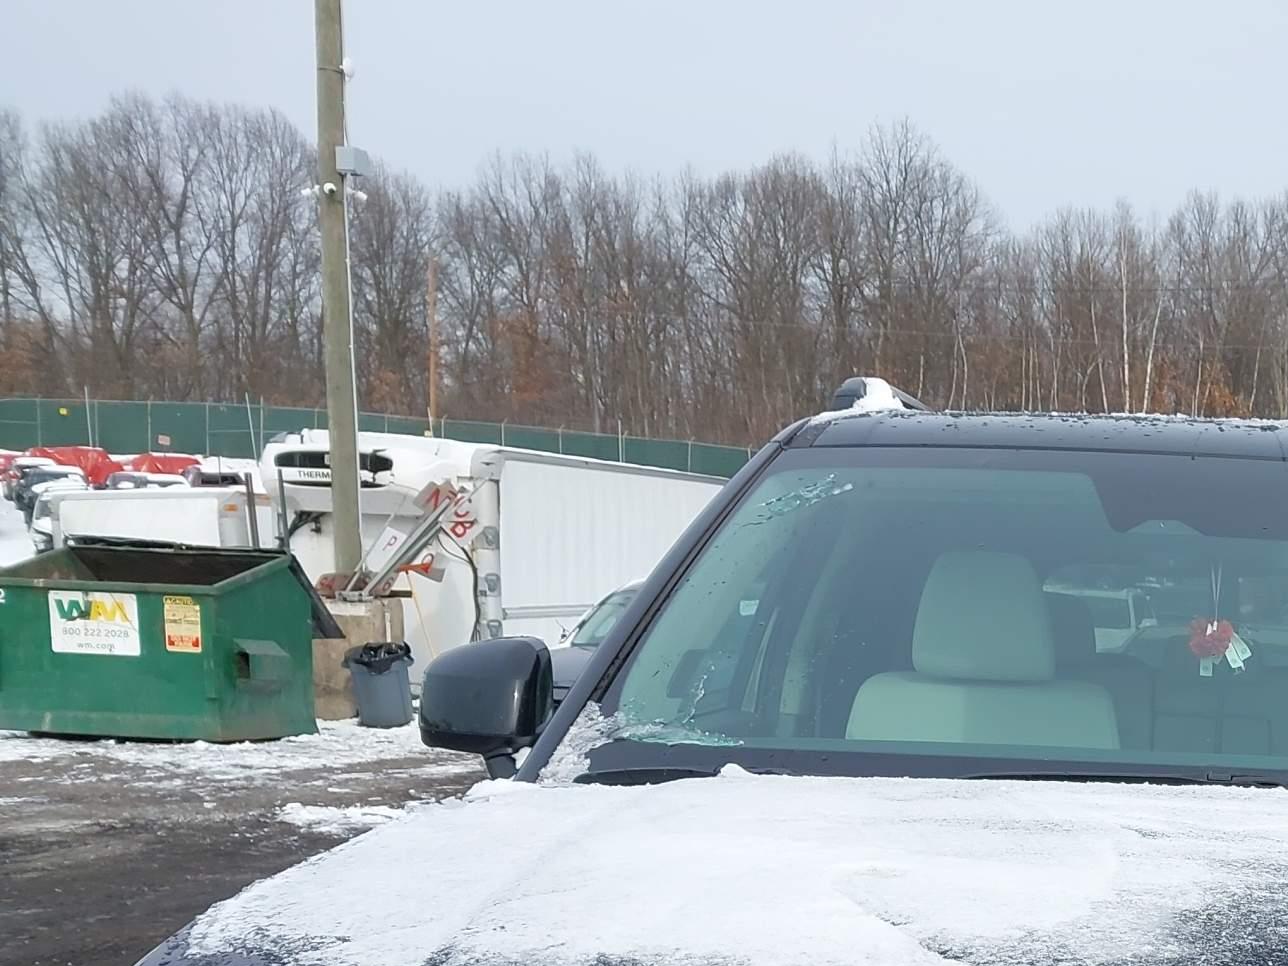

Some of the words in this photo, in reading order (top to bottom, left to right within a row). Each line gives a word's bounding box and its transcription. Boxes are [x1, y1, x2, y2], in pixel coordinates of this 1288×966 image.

[297, 470, 331, 479] THERM
[53, 599, 130, 623] WM
[62, 627, 81, 636] 800
[84, 628, 102, 637] 222
[103, 629, 130, 640] 2028
[77, 642, 116, 650] wm.com
